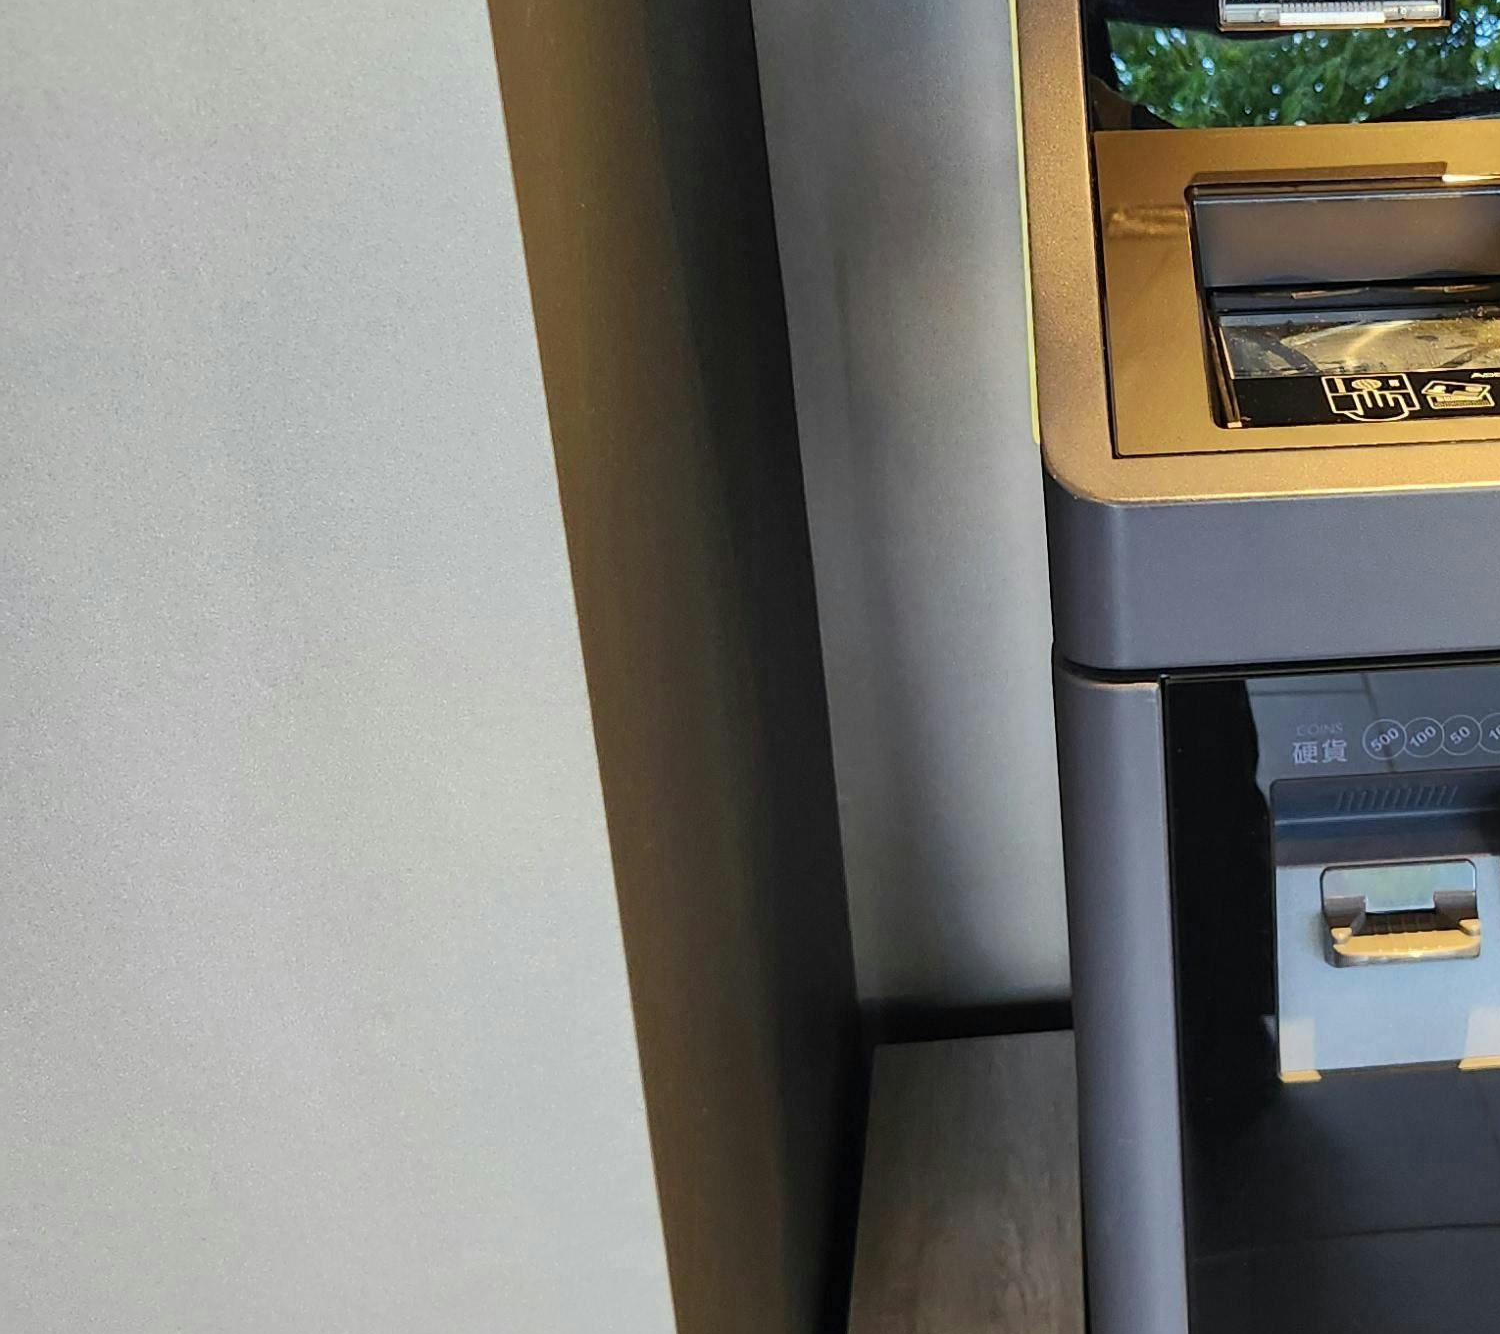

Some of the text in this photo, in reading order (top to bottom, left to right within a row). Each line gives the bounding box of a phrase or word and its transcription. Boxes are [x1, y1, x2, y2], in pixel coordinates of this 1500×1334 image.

[1292, 739, 1347, 764] 硬貨
[1371, 727, 1399, 752] 500
[1409, 725, 1437, 748] 100
[1450, 725, 1471, 745] 50
